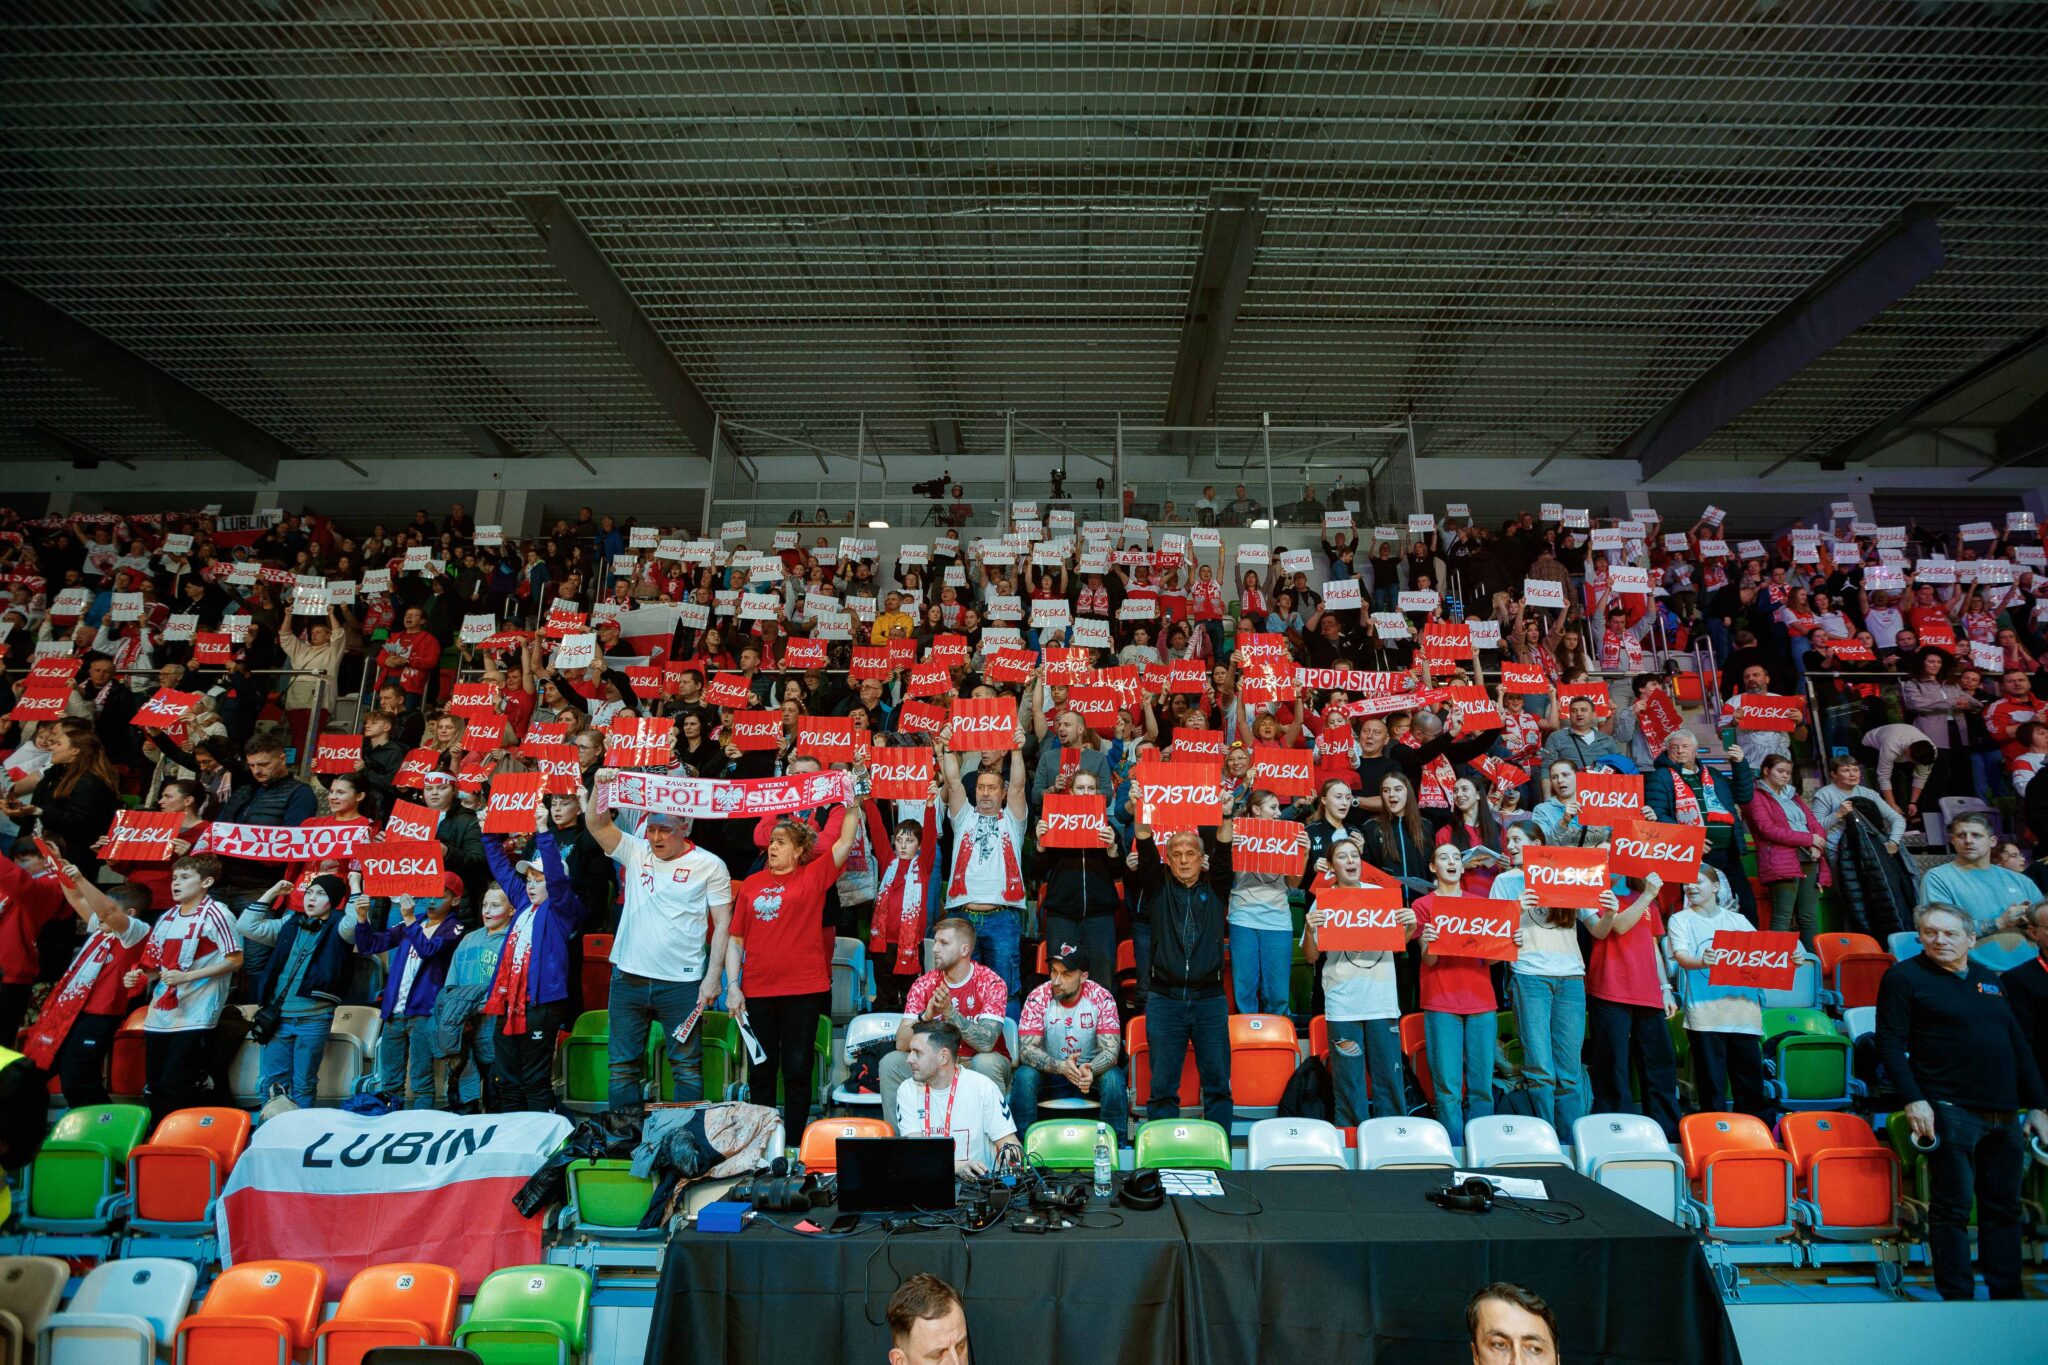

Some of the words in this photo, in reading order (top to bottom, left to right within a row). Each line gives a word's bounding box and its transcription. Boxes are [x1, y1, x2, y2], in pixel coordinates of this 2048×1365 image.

[223, 515, 269, 530] LUBLIN
[1051, 515, 1072, 523] POLSKA
[775, 535, 796, 543] POLSKA
[1193, 533, 1218, 541] POLSKA
[1593, 534, 1621, 542] POLSKA
[1034, 550, 1060, 558] POLSKA
[1283, 557, 1310, 565] POLSKA
[752, 564, 780, 573] POLSKA
[1919, 566, 1954, 575] POLSKA
[1979, 567, 2009, 575] POLSKA
[1612, 574, 1646, 584] POLSKA
[1326, 591, 1360, 599] POLSKA
[1527, 588, 1560, 598] POLSKA
[744, 602, 776, 611] POLSKA
[807, 602, 834, 611] POLSKA
[848, 604, 873, 614] POLSKA
[990, 603, 1018, 611] POLSKA
[1034, 608, 1067, 617] POLSKA
[1123, 605, 1152, 613] POLSKA
[820, 621, 849, 630] POLSKA
[1375, 621, 1405, 629] POLSKA
[1077, 626, 1107, 637] POLSKA
[984, 636, 1019, 645] POLSKA
[1426, 635, 1469, 647] POLSKA
[197, 643, 230, 653] POLSKA
[559, 644, 591, 656] POLSKA
[787, 646, 824, 658] POLSKA
[934, 644, 967, 655] POLSKA
[853, 657, 887, 669] POLSKA
[996, 656, 1031, 671] POLSKA
[1415, 657, 1449, 666] PLSKA
[33, 668, 73, 678] POLSKA
[911, 670, 947, 685] POLSKA
[1172, 669, 1207, 681] POLSKA
[1504, 672, 1544, 683] POLSKA
[1245, 677, 1291, 689] POLSKA
[1307, 670, 1390, 691] POLSKA
[711, 683, 748, 697] POLSKA
[17, 697, 64, 709] POLSKA
[452, 694, 492, 705] POLSKA
[1069, 699, 1114, 713] POLSKA
[1459, 700, 1495, 714] POLSKA
[1744, 707, 1790, 719] POLSKA
[904, 712, 939, 730] POLSKA
[952, 715, 1012, 733] POLSKA
[735, 723, 779, 735] POLSKA
[524, 732, 564, 744] POLSKA
[613, 733, 666, 749] POLSKA
[800, 731, 850, 746] POLSKA
[1175, 740, 1219, 754] POLSKA
[318, 747, 361, 760] POLSKA
[871, 763, 928, 782] POLSKA
[1258, 762, 1309, 779] POLSKA
[665, 780, 699, 788] ZAWSZE
[758, 781, 789, 789] WIERNI
[654, 788, 710, 806] POL
[746, 787, 801, 805] SKA
[1144, 785, 1219, 806] POLSKA
[1579, 790, 1639, 808] POLSKA
[489, 793, 536, 811] POLSKA
[748, 802, 800, 813] CZERWONYM
[386, 815, 431, 840] POLSKA
[1048, 813, 1106, 831] POLSKA
[113, 828, 173, 843] POLSKA
[1239, 835, 1299, 856] POLSKA
[1615, 838, 1695, 862] POLSKA
[364, 858, 438, 876] POLSKA
[1528, 865, 1604, 886] POLSKA
[1323, 909, 1397, 929] POLSKA
[1435, 916, 1512, 938] POLSKA
[1714, 948, 1788, 968] POLSKA
[846, 1128, 853, 1136] 31
[1290, 1128, 1298, 1136] 35
[1398, 1127, 1407, 1135] 36
[1505, 1125, 1514, 1133] 37
[302, 1124, 498, 1168] LUBIN
[267, 1275, 278, 1283] 27
[400, 1278, 411, 1287] 28
[531, 1280, 542, 1288] 29
